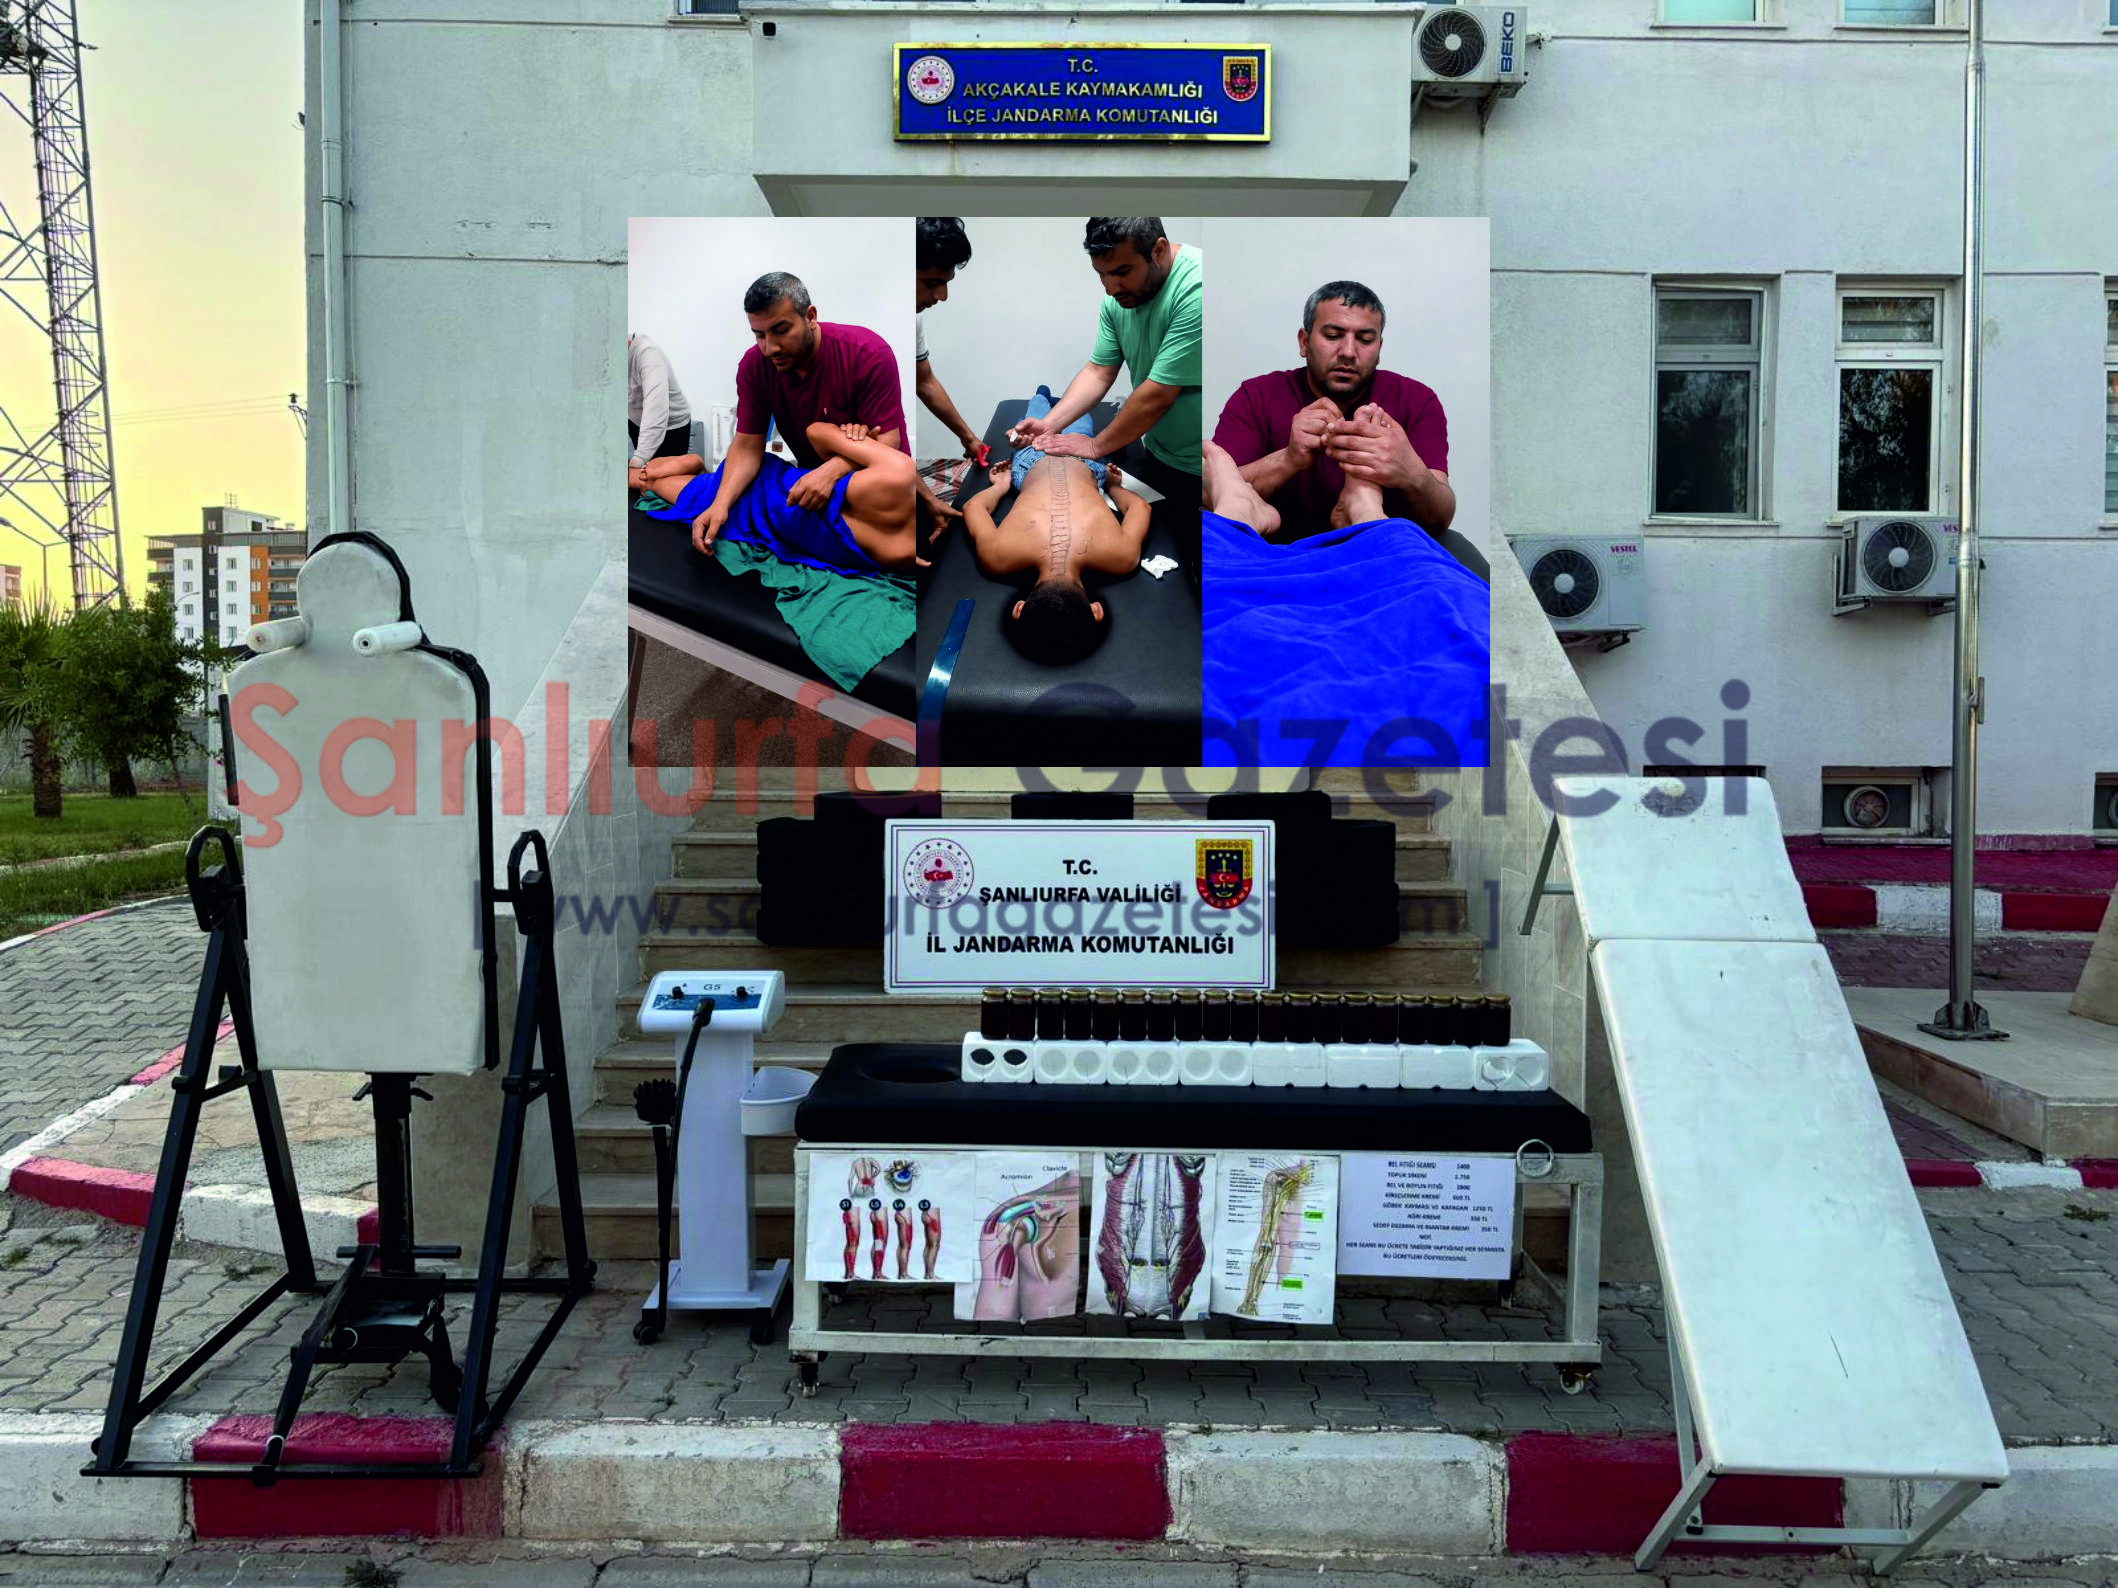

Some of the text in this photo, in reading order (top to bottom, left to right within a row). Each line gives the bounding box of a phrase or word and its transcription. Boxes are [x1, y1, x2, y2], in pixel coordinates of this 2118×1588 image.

[1501, 12, 1514, 72] BEKO
[1067, 59, 1098, 73] T.C.
[963, 83, 1060, 100] AKÇAKALE
[1066, 80, 1202, 99] KAYMAKAMLIĞI
[947, 106, 1218, 126] İLÇE JANDARMA KOMUTANLIĞI
[1062, 860, 1098, 875] T.C.
[979, 883, 1181, 907] ŞANLIURFA VALİLİĞİ
[926, 932, 1234, 954] İL JANDARMA KOMUTANLIĞI
[703, 983, 721, 991] G5
